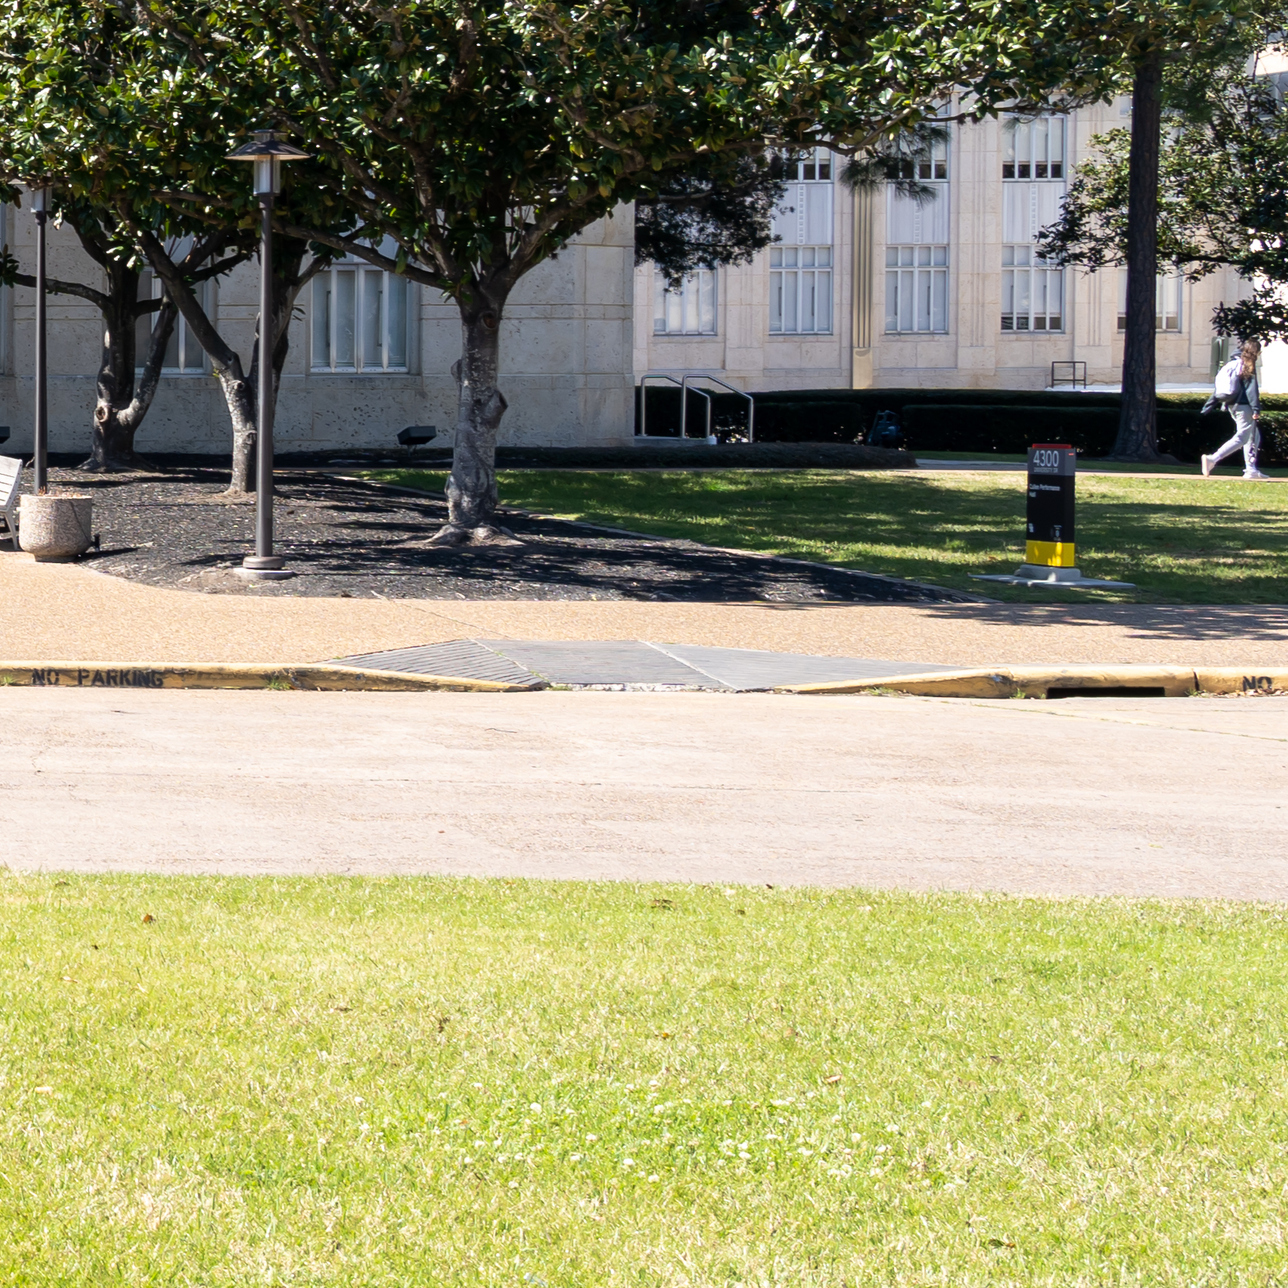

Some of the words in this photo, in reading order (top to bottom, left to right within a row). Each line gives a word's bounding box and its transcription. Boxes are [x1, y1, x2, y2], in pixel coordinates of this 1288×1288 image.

[1033, 450, 1059, 467] 4300
[32, 668, 60, 685] NO
[77, 669, 164, 688] PARKING
[1242, 676, 1273, 692] NO
